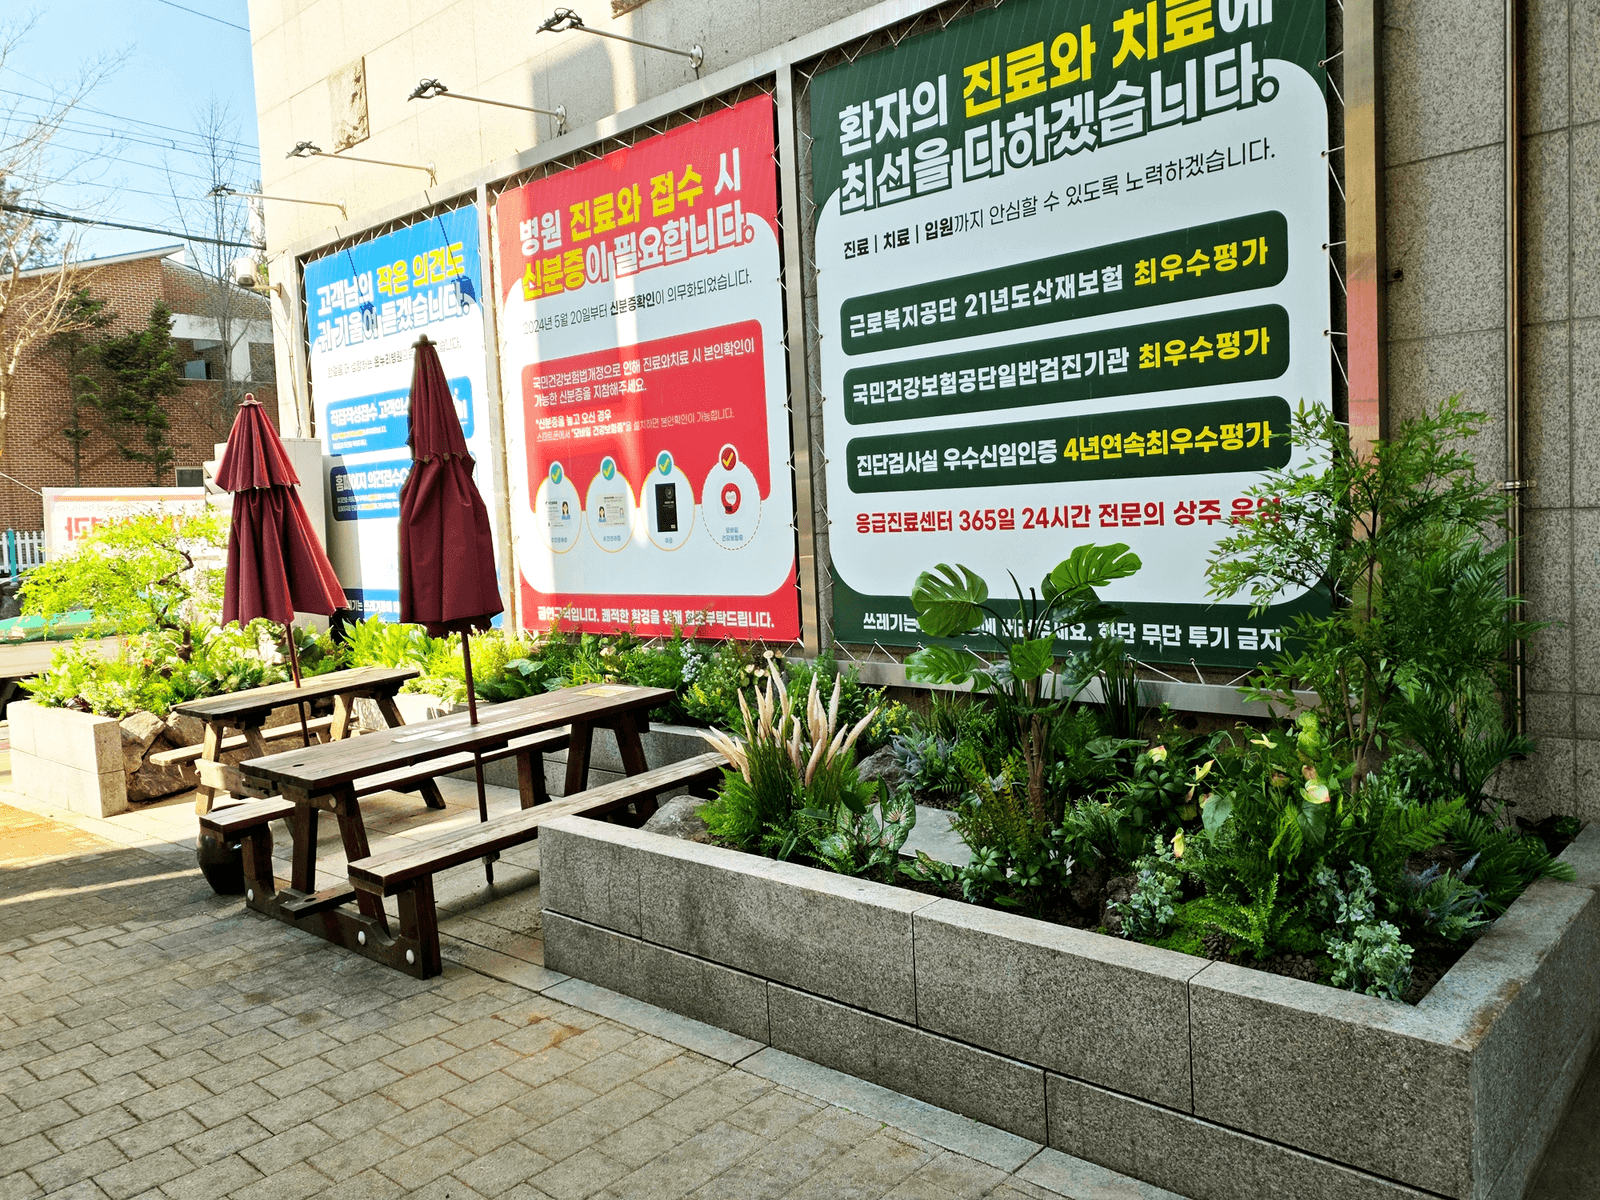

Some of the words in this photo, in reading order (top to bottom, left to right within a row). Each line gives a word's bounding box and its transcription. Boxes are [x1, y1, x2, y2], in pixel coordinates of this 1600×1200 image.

[838, 73, 948, 157] 환자의
[963, 23, 1096, 118] 진료와
[841, 137, 951, 213] 최선을
[964, 41, 1278, 179] 다하겠습니다.
[519, 209, 562, 256] 병원
[569, 182, 642, 242] 진료와
[650, 164, 704, 218] 접수
[714, 147, 741, 195] 시
[843, 237, 870, 260] 진료
[883, 227, 911, 250] 치료
[924, 209, 984, 241] 입원까지
[988, 195, 1039, 226] 안심할
[1043, 190, 1060, 213] 수
[1065, 174, 1120, 207] 있도록
[1125, 137, 1276, 193] 노력하겠습니다.
[316, 271, 375, 317] 고객님의
[377, 260, 409, 296] 작은
[412, 241, 466, 287] 의견도
[522, 240, 608, 300] 신분증이
[614, 200, 755, 278] 필요합니다.
[523, 316, 553, 335] 2024년
[554, 311, 569, 328] 5월
[570, 302, 608, 325] 20일부터
[610, 289, 665, 316] 신분증확인이
[667, 267, 753, 303] 의무화되었습니다.
[849, 296, 958, 339] 근로복지공단
[964, 263, 1123, 319] 21년도산재보험
[1134, 235, 1269, 288] 최우수평가
[532, 362, 622, 390] 국민건강보험법개정으로
[622, 359, 641, 376] 인해
[643, 349, 690, 372] 진료와치료
[691, 348, 702, 363] 시
[703, 336, 755, 362] 본인확인이
[534, 391, 558, 408] 가능한
[559, 386, 592, 404] 신분증을
[593, 377, 647, 399] 지참해주세요.
[852, 346, 1130, 406] 국민건강보험공단일반검진기관
[1138, 326, 1271, 371] 최우수평가
[581, 411, 596, 424] 오신
[597, 409, 612, 423] 경우
[856, 446, 939, 477] 진단검사실
[943, 438, 1058, 471] 우수신임인증
[1063, 420, 1272, 463] 4년연속최우수평가
[855, 510, 954, 534] 응급진료센터
[958, 507, 1016, 532] 365일
[1021, 503, 1092, 530] 24시간
[1098, 500, 1166, 528] 전문의
[1173, 500, 1222, 526] 상주
[601, 608, 630, 624] 쾌적한
[630, 608, 660, 625] 환경을
[862, 612, 919, 634] 쓰레기는
[1142, 623, 1182, 647] 무단
[1188, 625, 1230, 649] 투기
[1237, 626, 1282, 652] 금지
